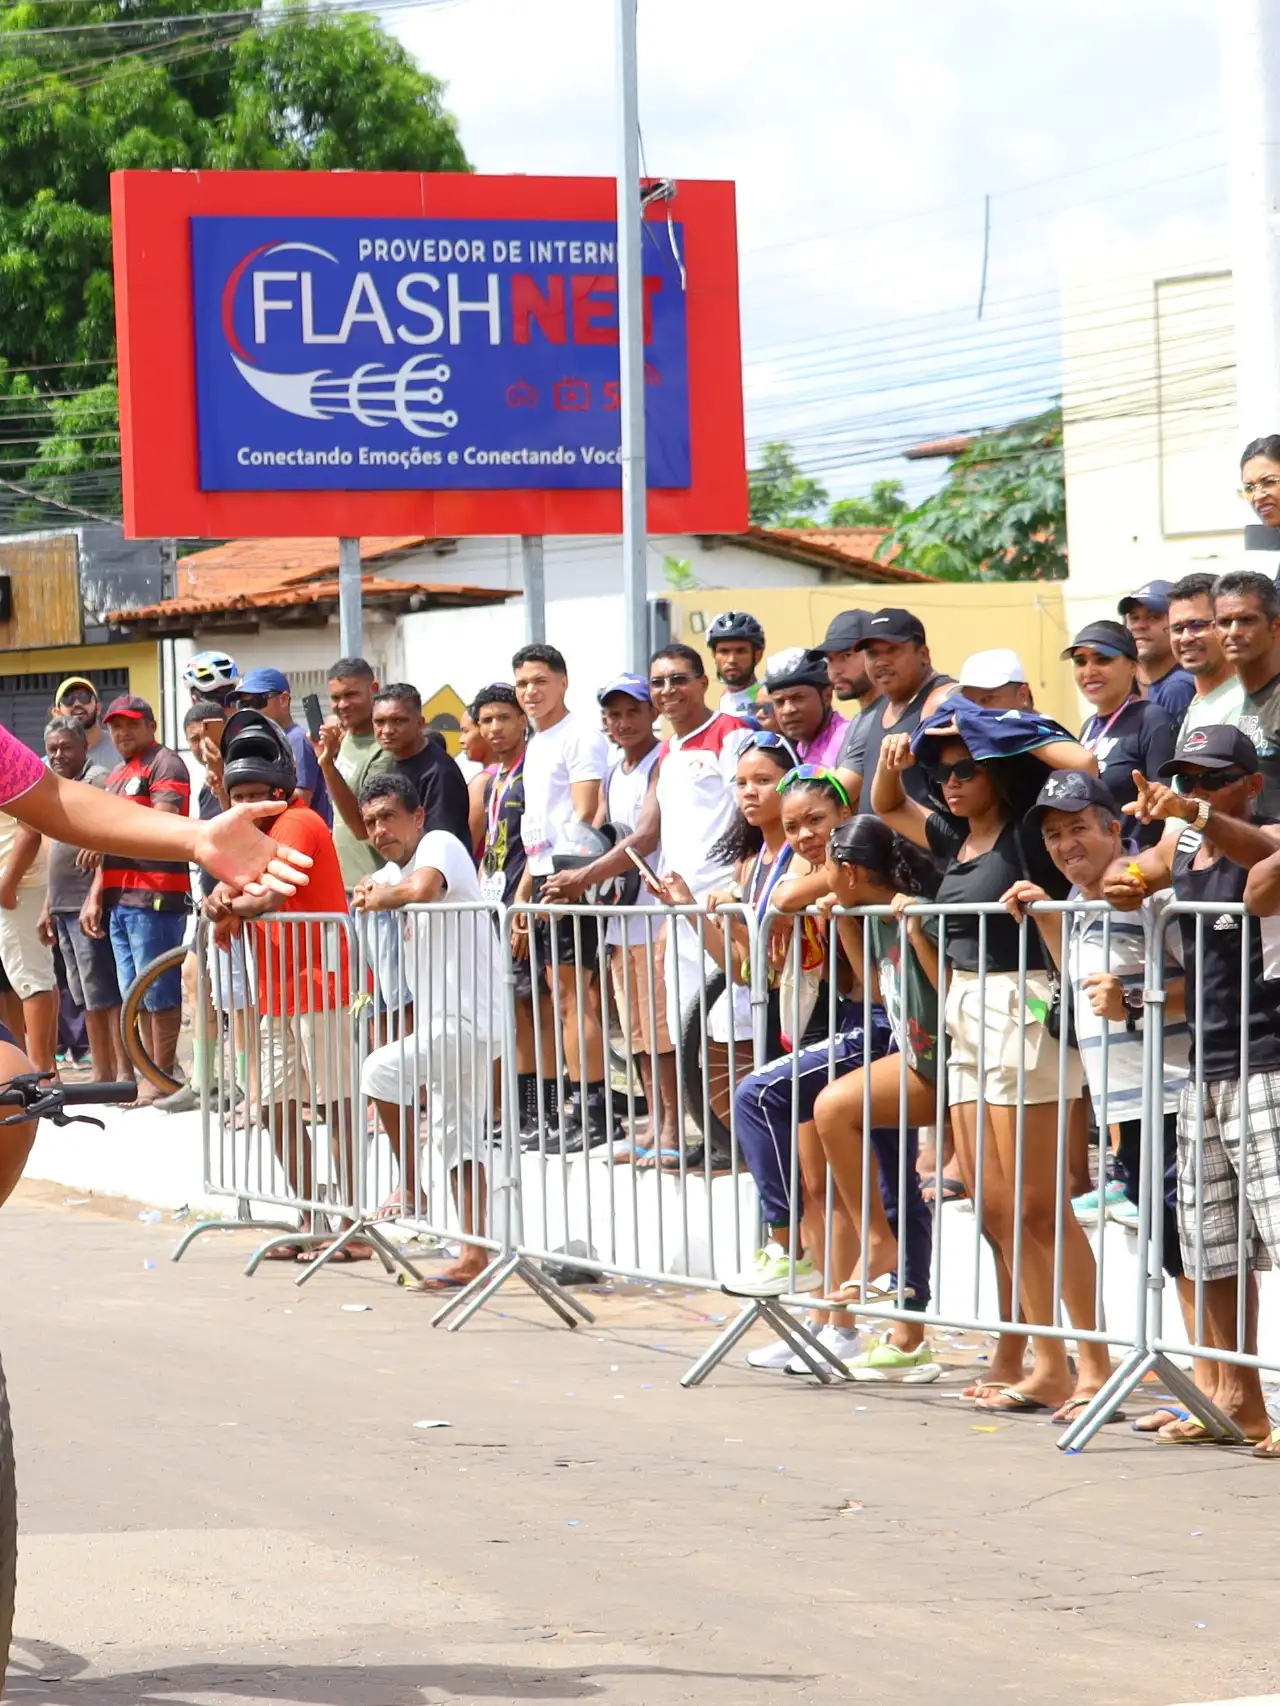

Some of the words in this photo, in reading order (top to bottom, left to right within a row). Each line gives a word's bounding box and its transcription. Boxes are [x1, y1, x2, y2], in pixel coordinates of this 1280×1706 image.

[358, 238, 486, 263] PROVEDOR
[492, 239, 523, 263] DE
[529, 240, 643, 264] INTERN
[237, 446, 353, 465] Conectando
[358, 446, 442, 470] Emoções
[447, 450, 459, 465] e
[463, 446, 576, 465] Conectando
